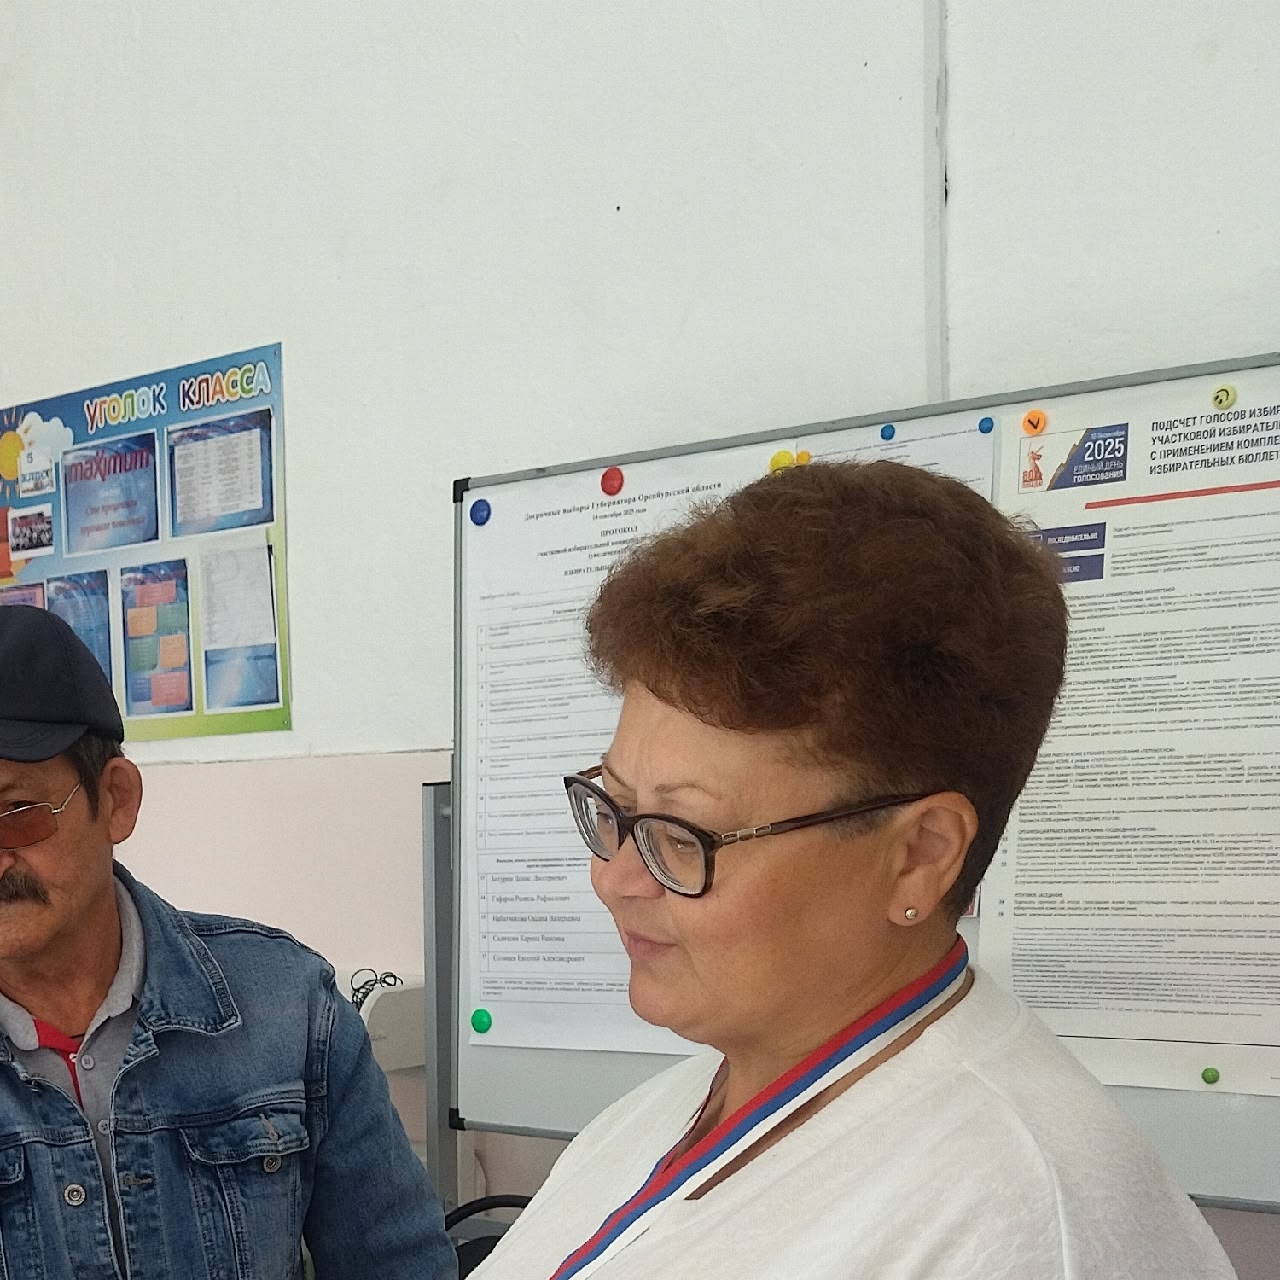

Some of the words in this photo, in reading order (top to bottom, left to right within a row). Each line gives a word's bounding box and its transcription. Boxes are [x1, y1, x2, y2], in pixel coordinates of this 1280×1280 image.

[84, 383, 167, 433] УГОЛОК
[180, 362, 271, 412] КЛАССА
[1152, 416, 1197, 431] ПОДСЧЕТ
[1200, 409, 1246, 425] ГОЛОСОВ
[1150, 451, 1156, 460] С
[1159, 441, 1234, 460] ПРИМЕНЕНИЕМ
[1237, 435, 1280, 450] КОМПЛЕ
[1151, 427, 1216, 446] УЧАСТКОВОЙ
[1084, 438, 1125, 462] 2025
[1073, 462, 1103, 475] ЕДИНЫЙ
[1149, 456, 1235, 475] ИЗБИРАТЕЛЬНЫХ
